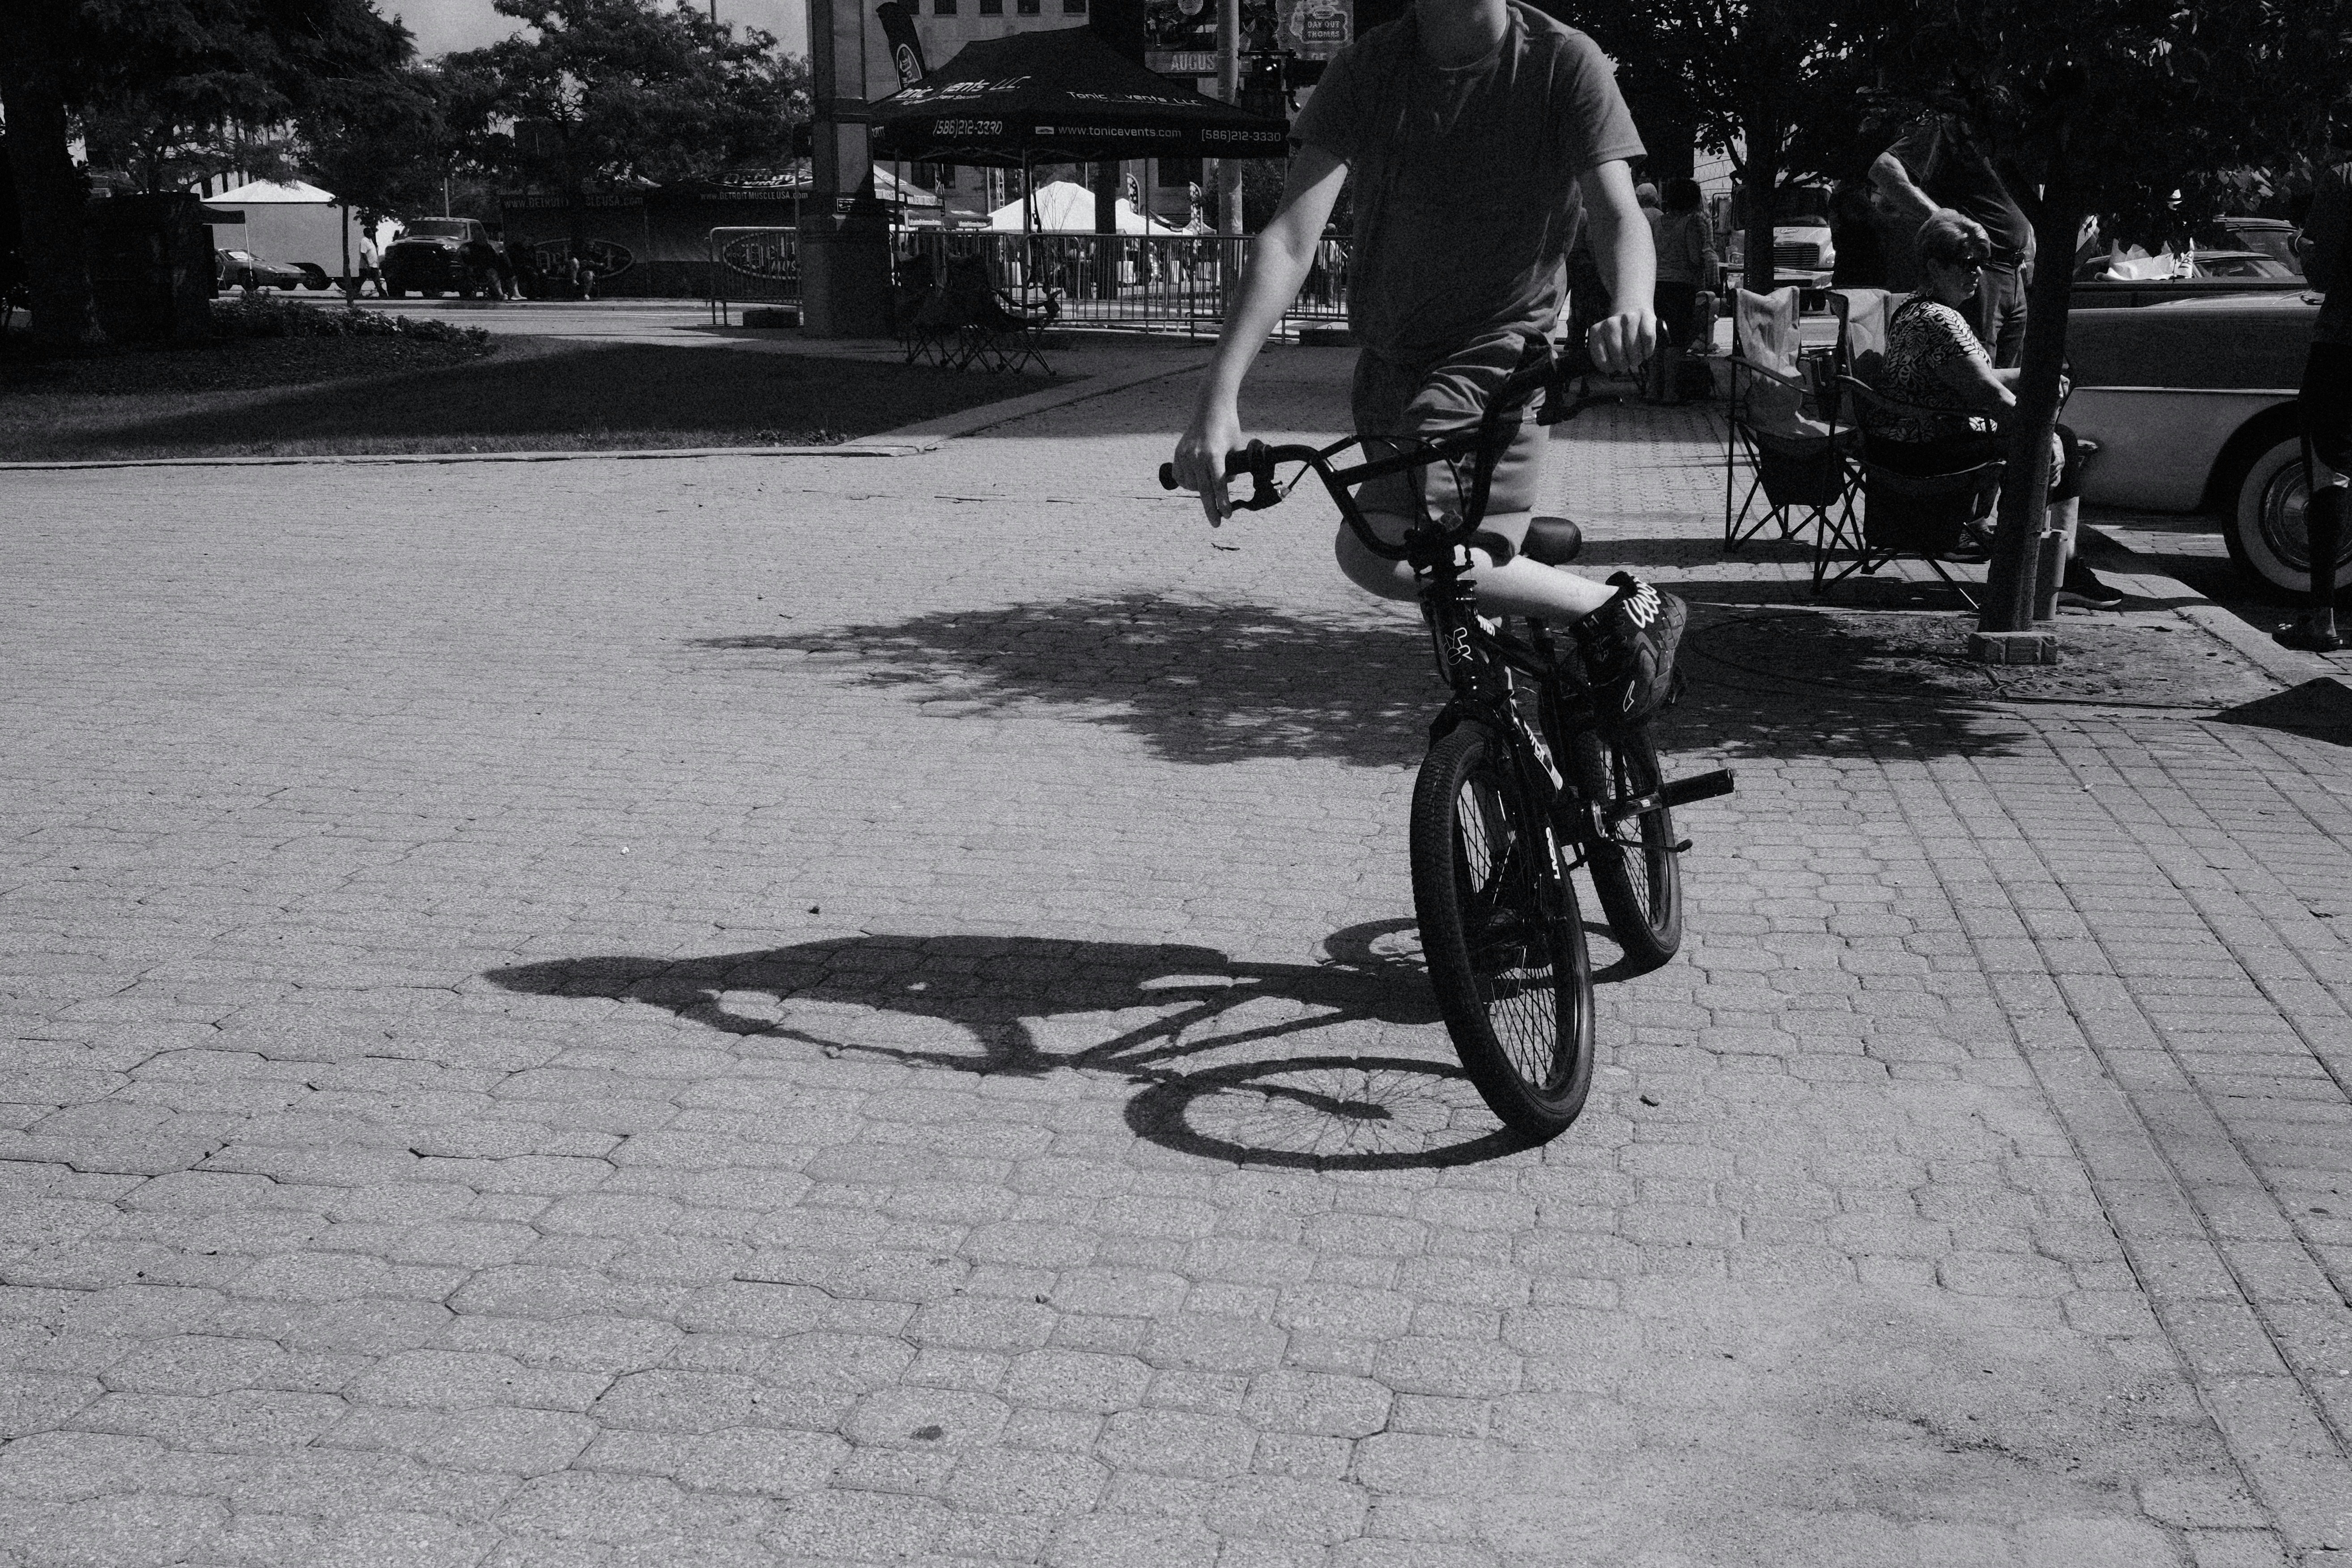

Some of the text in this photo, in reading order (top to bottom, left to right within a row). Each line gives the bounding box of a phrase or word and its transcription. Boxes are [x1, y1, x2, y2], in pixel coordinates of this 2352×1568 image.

[1170, 54, 1216, 71] AUGUS
[1066, 91, 1108, 99] Tonic
[1059, 126, 1182, 138] www.tonicevents.com
